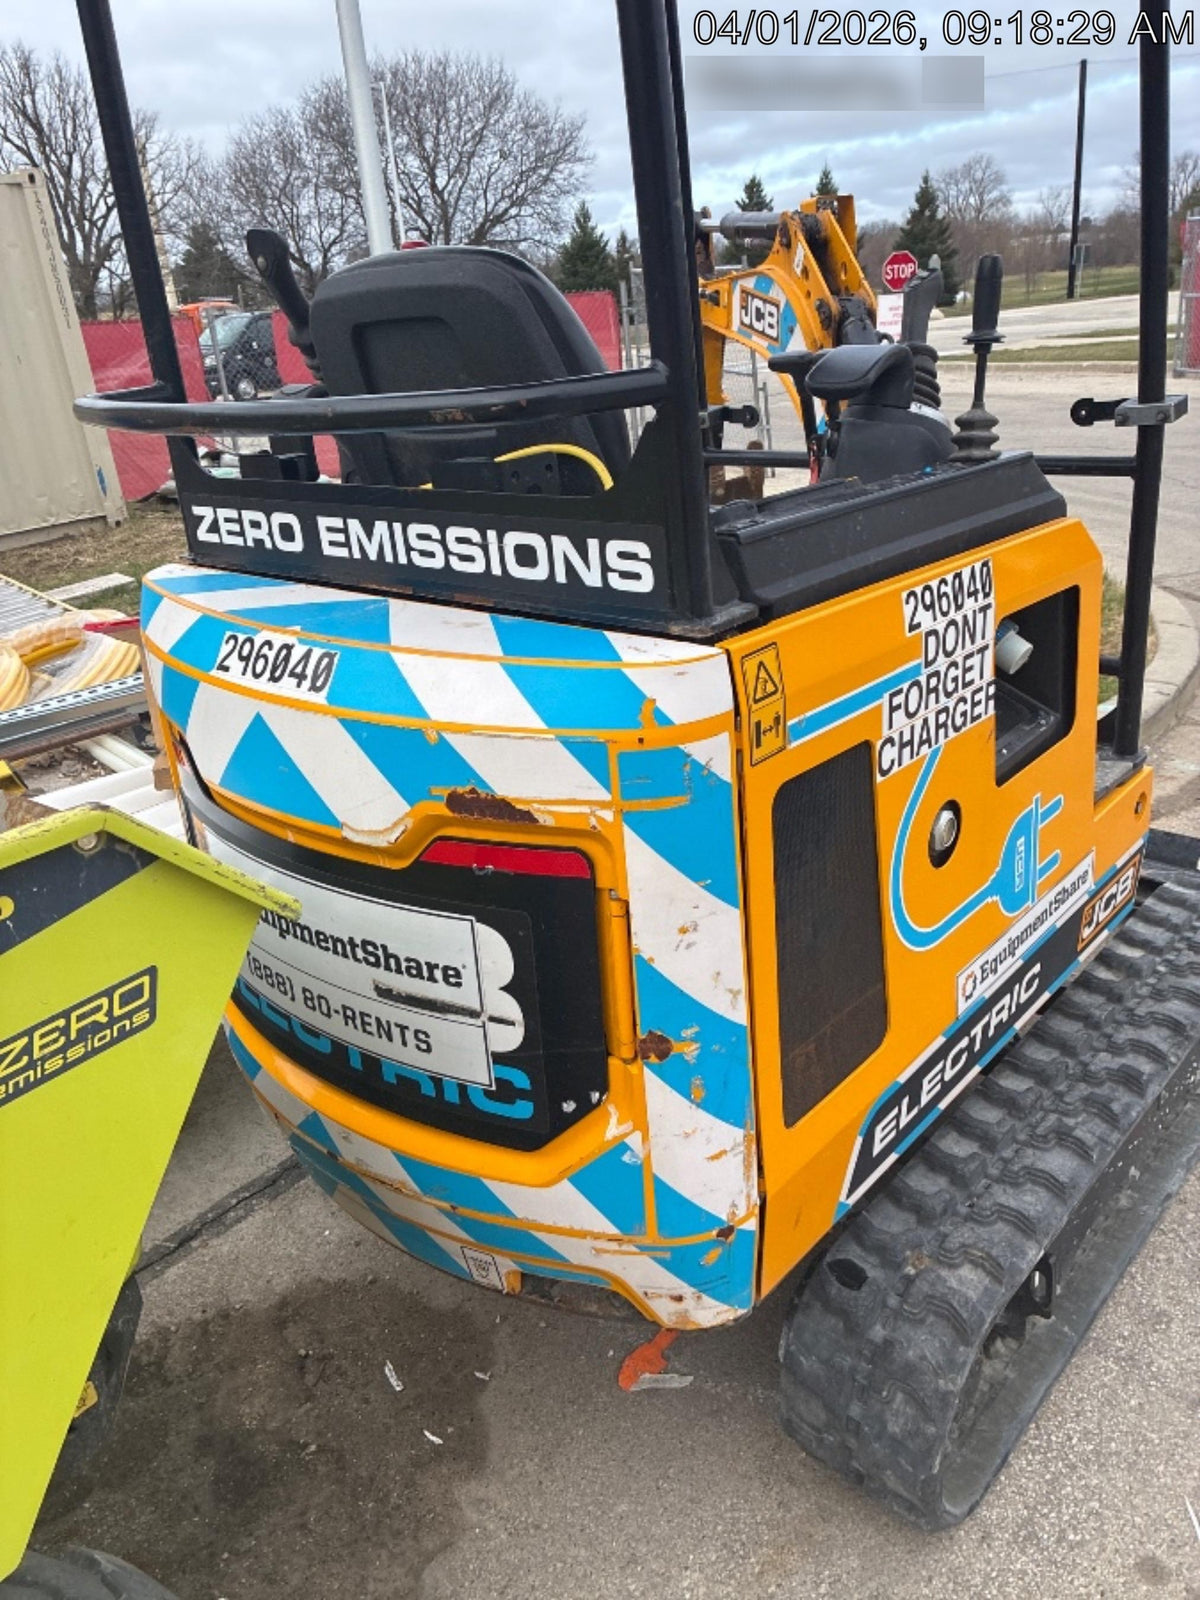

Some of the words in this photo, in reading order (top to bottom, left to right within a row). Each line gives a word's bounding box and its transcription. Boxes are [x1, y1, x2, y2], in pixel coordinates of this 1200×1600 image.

[885, 262, 915, 280] STOP
[741, 294, 778, 338] JCB
[192, 505, 304, 552] ZERO
[316, 515, 655, 593] EMISSIONS
[904, 558, 993, 634] 296040
[216, 633, 340, 693] 296040
[924, 602, 993, 670] DONT
[888, 643, 990, 731] FORGET
[877, 681, 996, 778] CHARGER
[979, 866, 1090, 985] EquipmentShare
[1082, 867, 1136, 939] JCB
[256, 907, 463, 988] uipmentShare
[301, 985, 433, 1054] 80-RENTS
[872, 962, 1042, 1157] ELECTRIC
